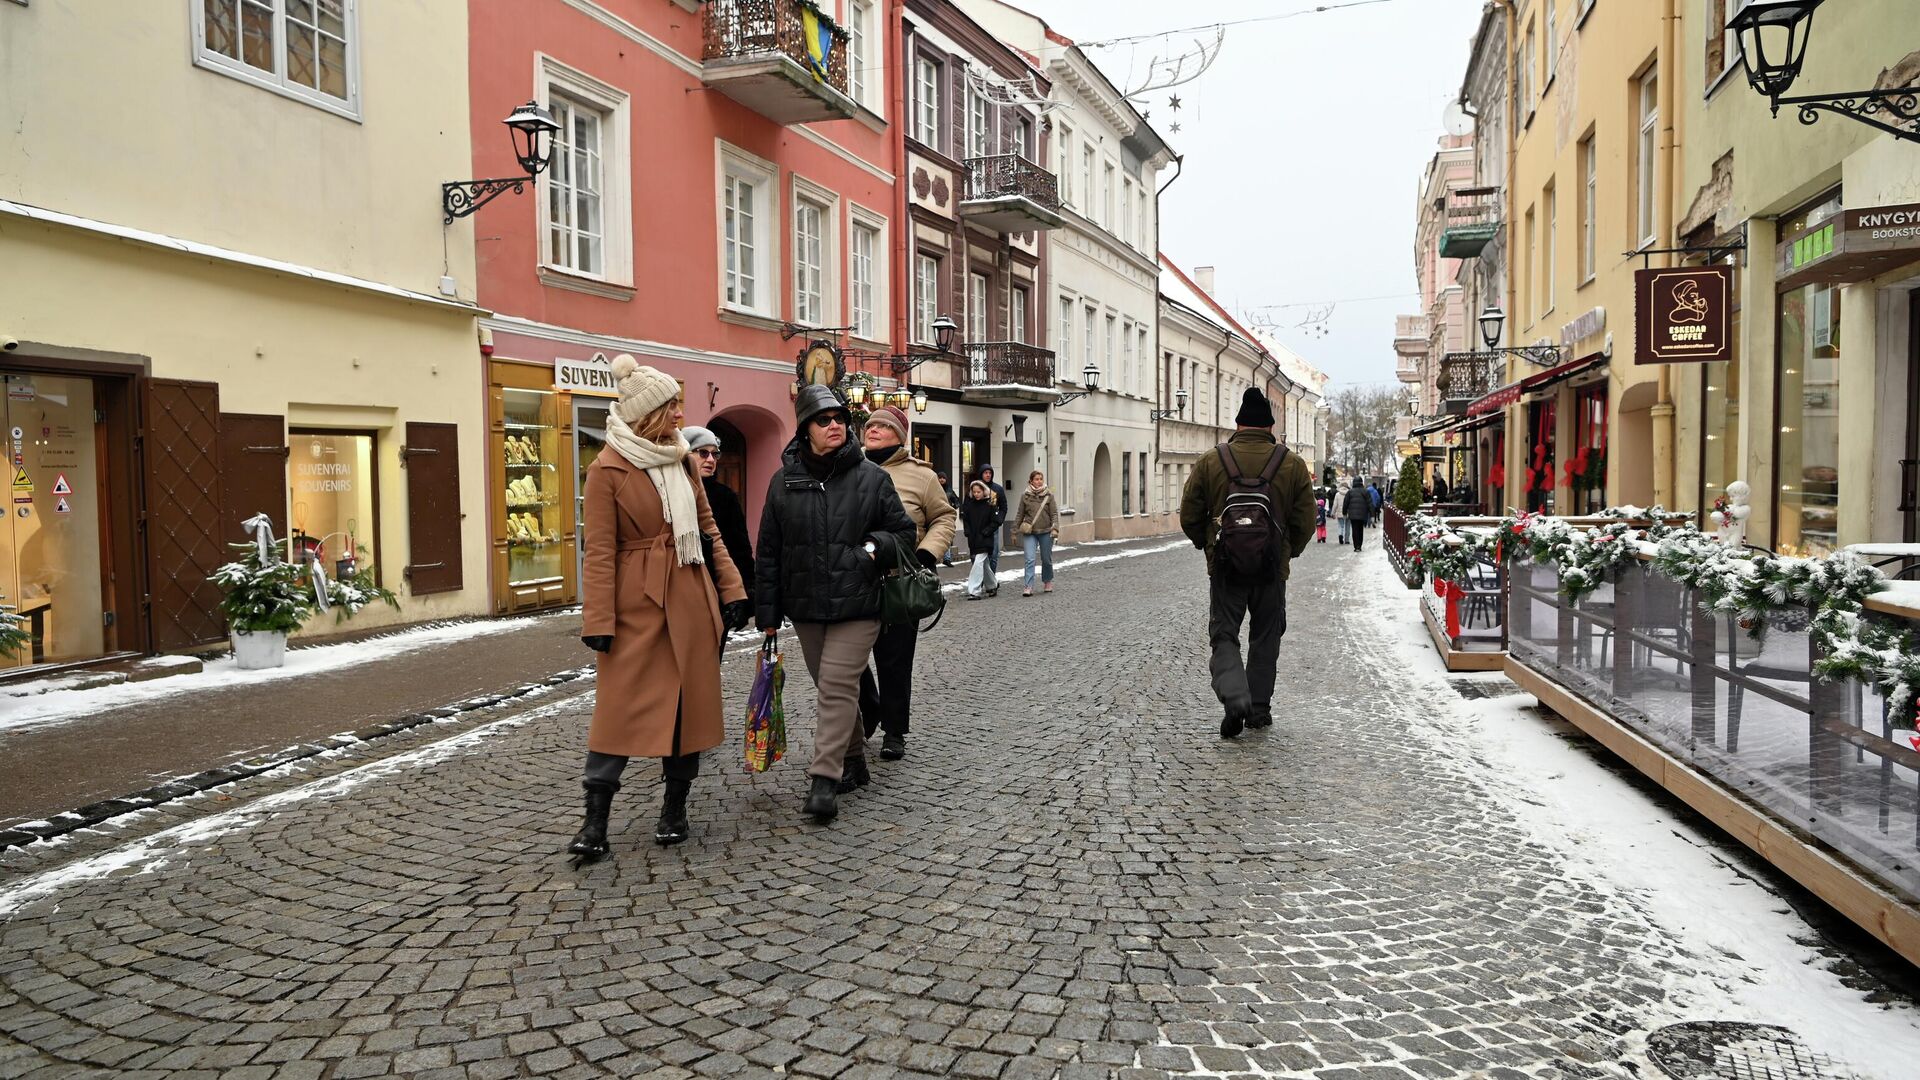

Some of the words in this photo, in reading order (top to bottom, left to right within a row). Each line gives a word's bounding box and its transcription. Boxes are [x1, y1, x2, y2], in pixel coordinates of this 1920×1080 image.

[1669, 325, 1707, 334] ESKEDAR
[1672, 333, 1703, 341] COFFEE
[297, 463, 352, 476] SUVENYRAI
[297, 479, 352, 492] SOUVENIRS
